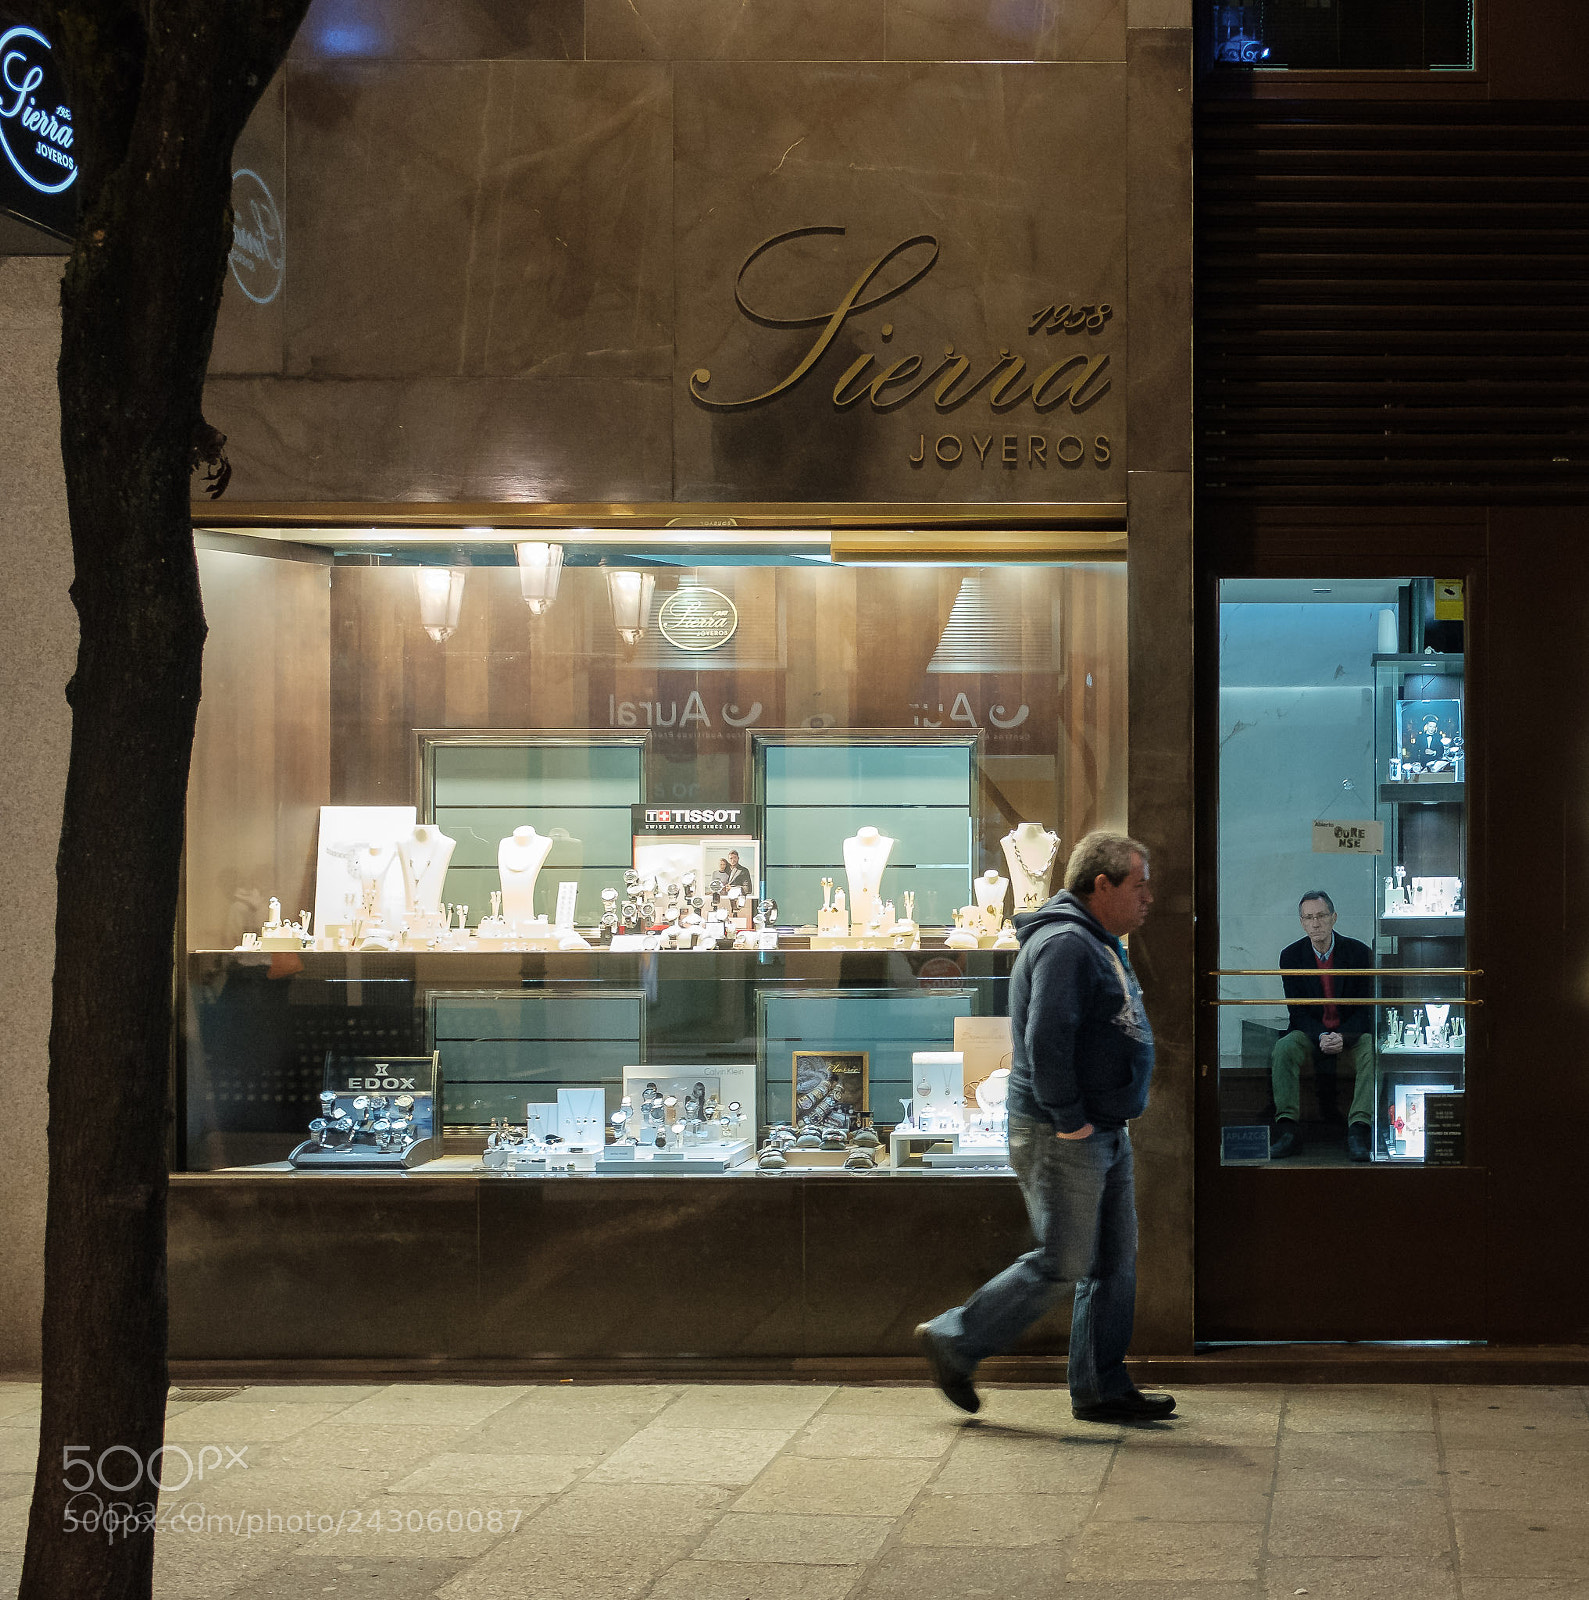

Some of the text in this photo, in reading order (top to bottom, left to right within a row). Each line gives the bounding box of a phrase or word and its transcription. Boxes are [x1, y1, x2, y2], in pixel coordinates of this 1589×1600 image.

[0, 50, 74, 149] Sierra
[35, 141, 75, 170] JOYEROS
[689, 225, 1111, 408] Sierra
[1028, 303, 1112, 336] 1958
[909, 434, 1112, 464] JOYEROS
[671, 809, 741, 823] TISSOT
[348, 1077, 415, 1090] EDOX
[726, 1067, 744, 1076] Klein
